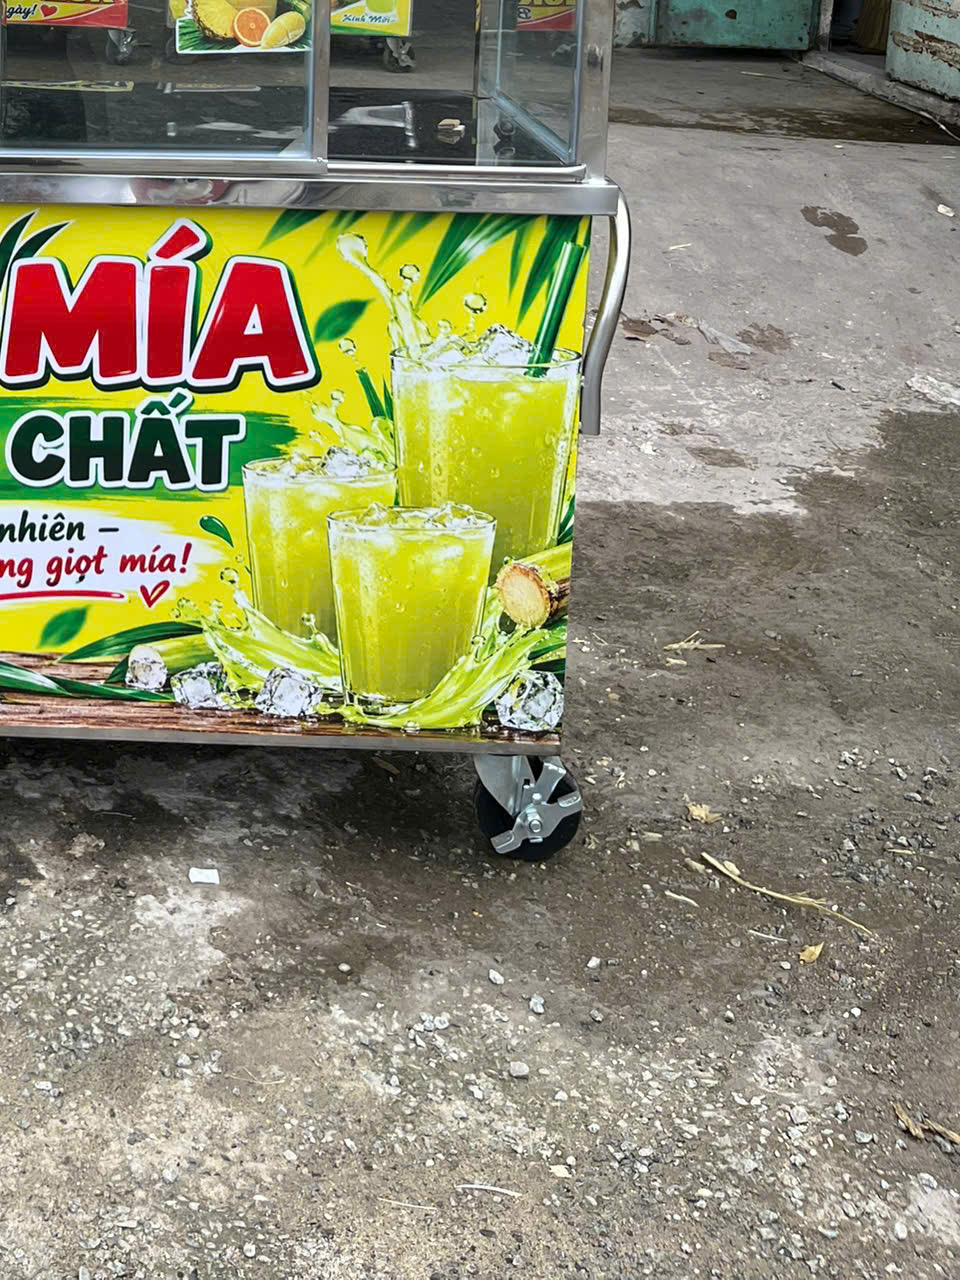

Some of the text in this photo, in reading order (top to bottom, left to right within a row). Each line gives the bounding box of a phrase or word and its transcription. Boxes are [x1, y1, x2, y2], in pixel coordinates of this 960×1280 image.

[6, 4, 38, 19] gày!
[1, 222, 318, 391] MÍA
[10, 390, 246, 490] CHẤT
[45, 545, 108, 587] giọt
[119, 542, 193, 575] mía!
